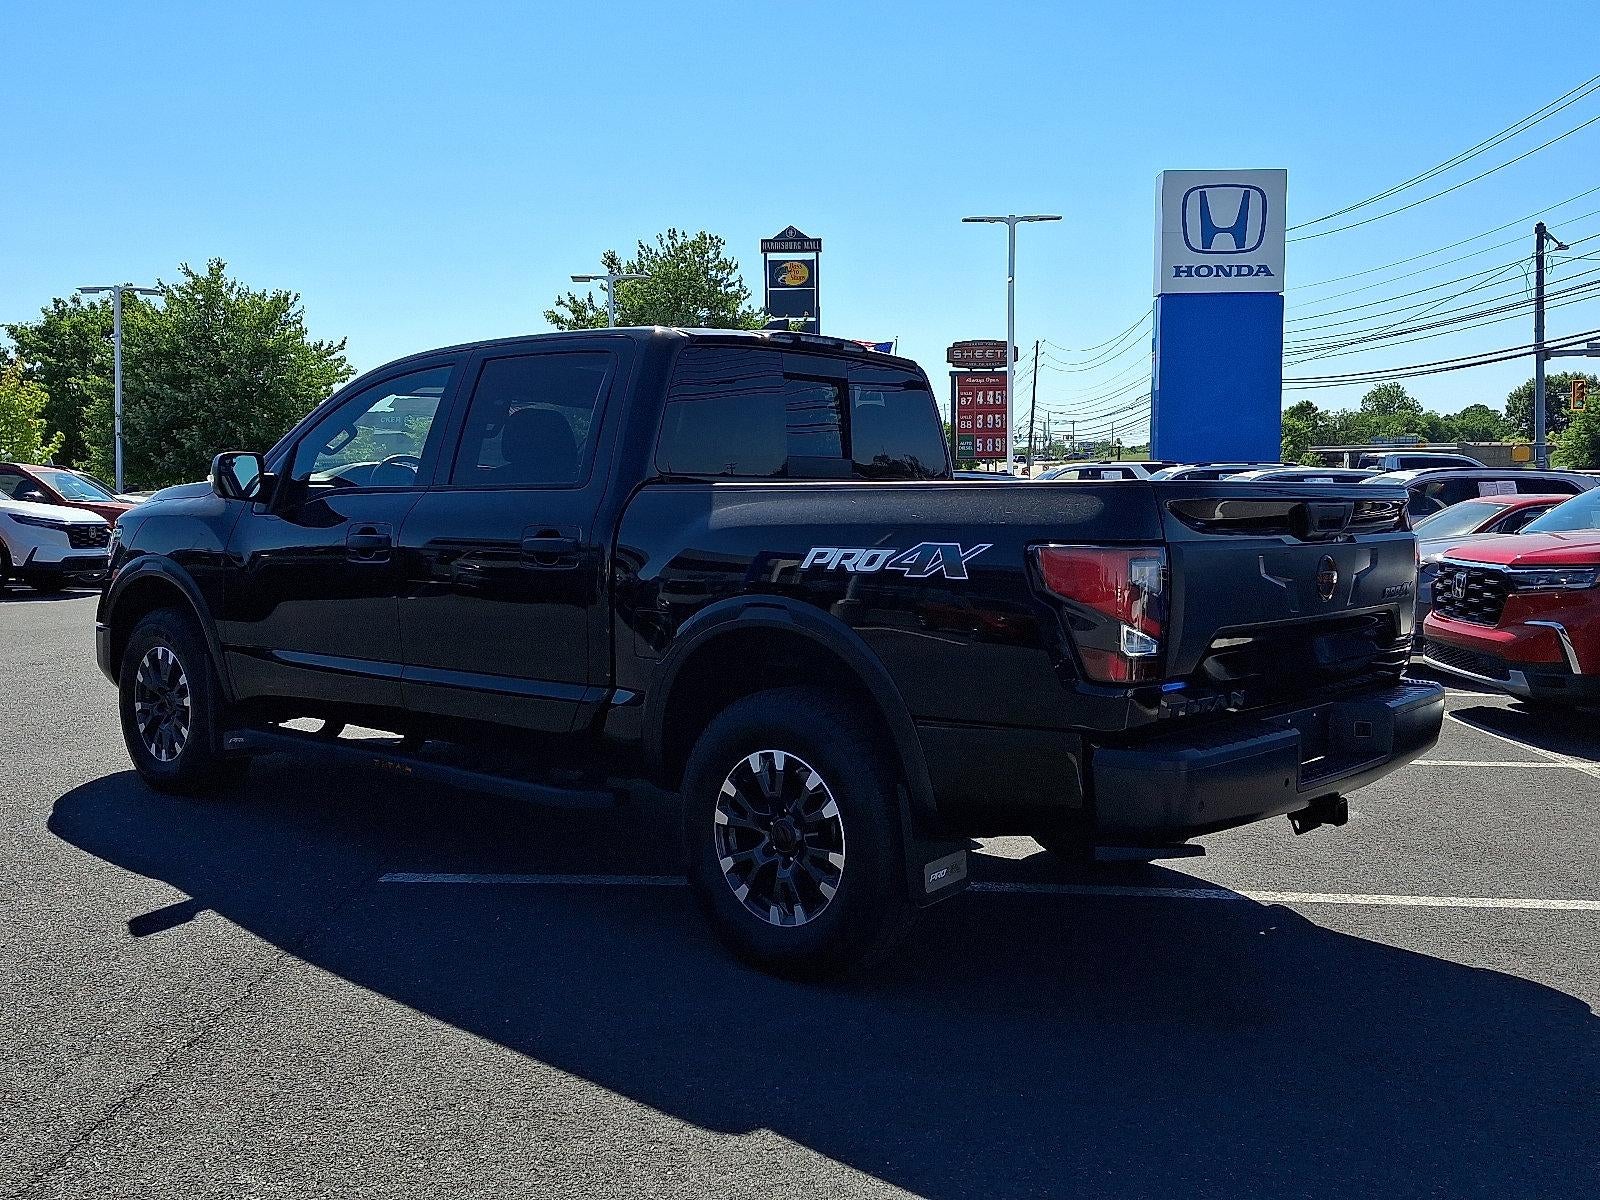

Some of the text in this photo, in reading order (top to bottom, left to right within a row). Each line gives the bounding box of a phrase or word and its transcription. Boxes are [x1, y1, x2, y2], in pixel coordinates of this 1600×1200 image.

[762, 241, 819, 250] HARRISBURG MALL
[1172, 264, 1275, 278] HONDA
[960, 397, 973, 405] 87
[960, 421, 972, 429] 88
